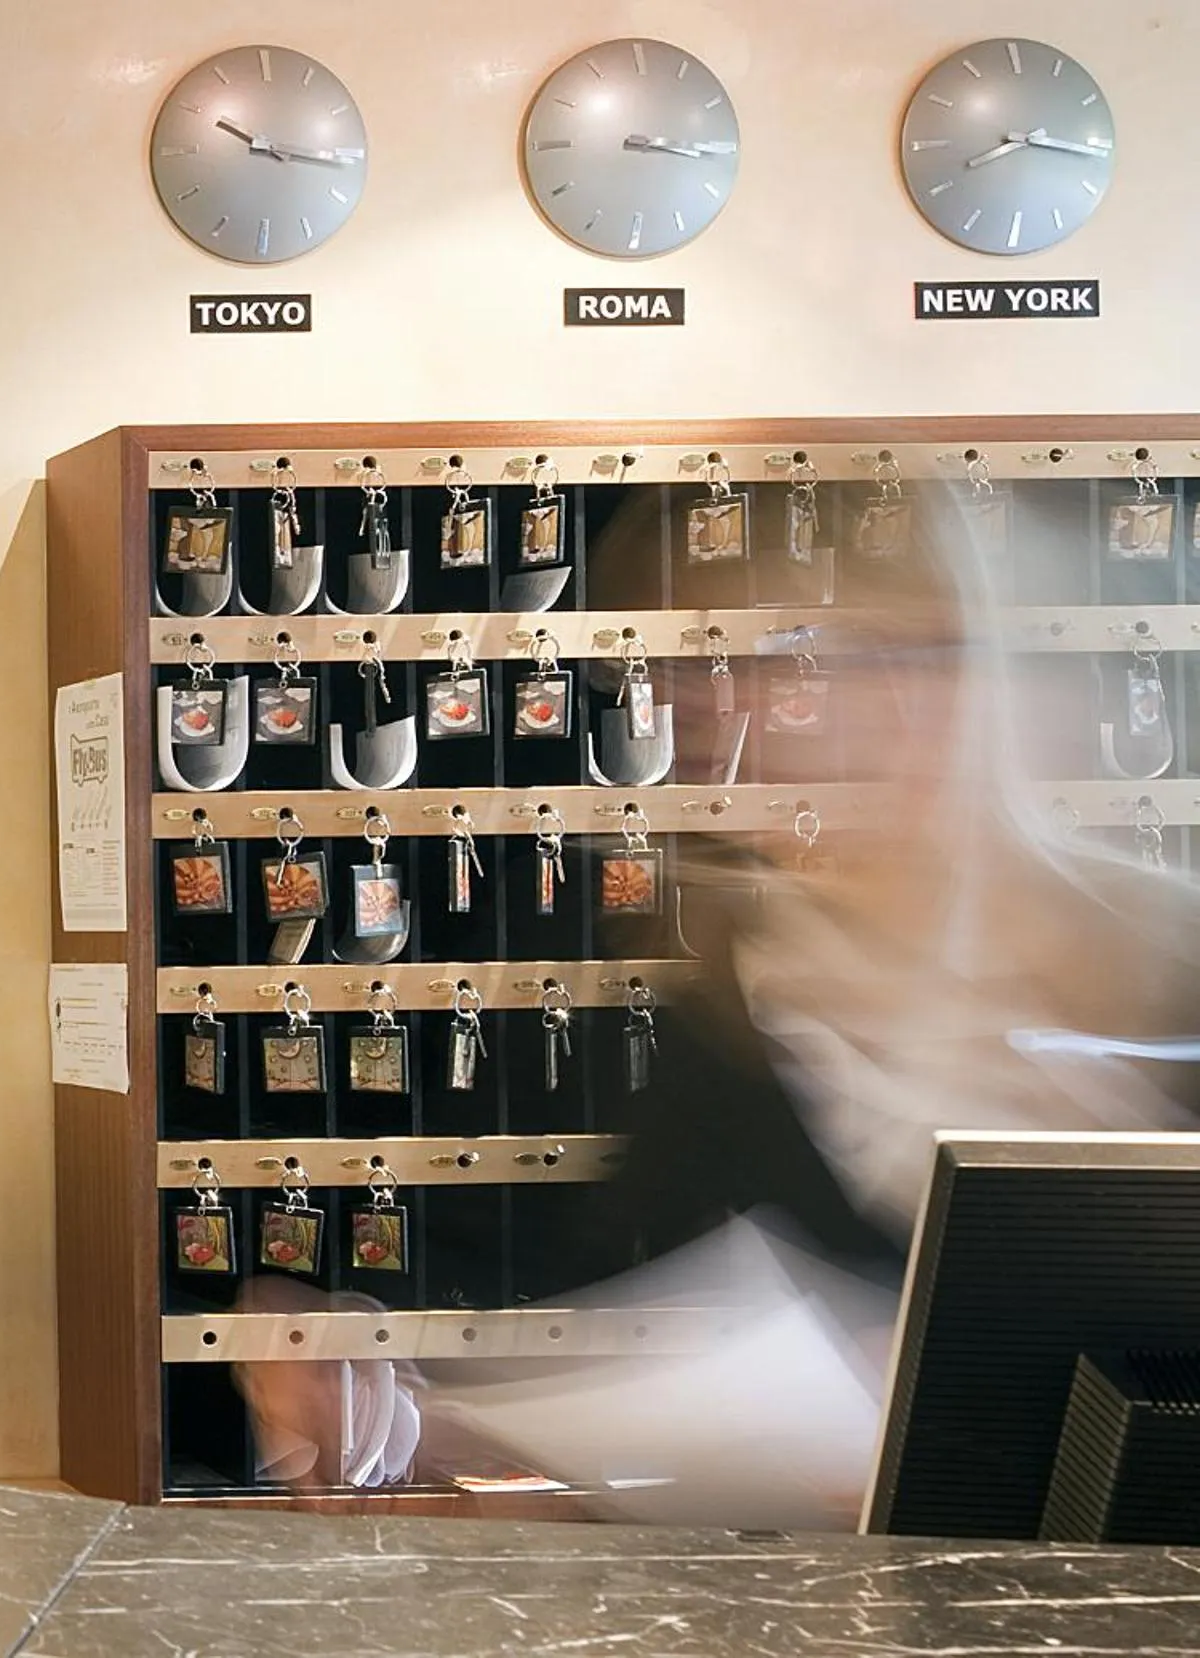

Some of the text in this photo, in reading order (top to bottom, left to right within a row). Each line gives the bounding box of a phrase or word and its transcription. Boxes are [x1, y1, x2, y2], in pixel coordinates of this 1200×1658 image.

[578, 295, 672, 319] ROMA
[923, 287, 1094, 312] NEW YORK
[195, 301, 306, 326] TOKYO
